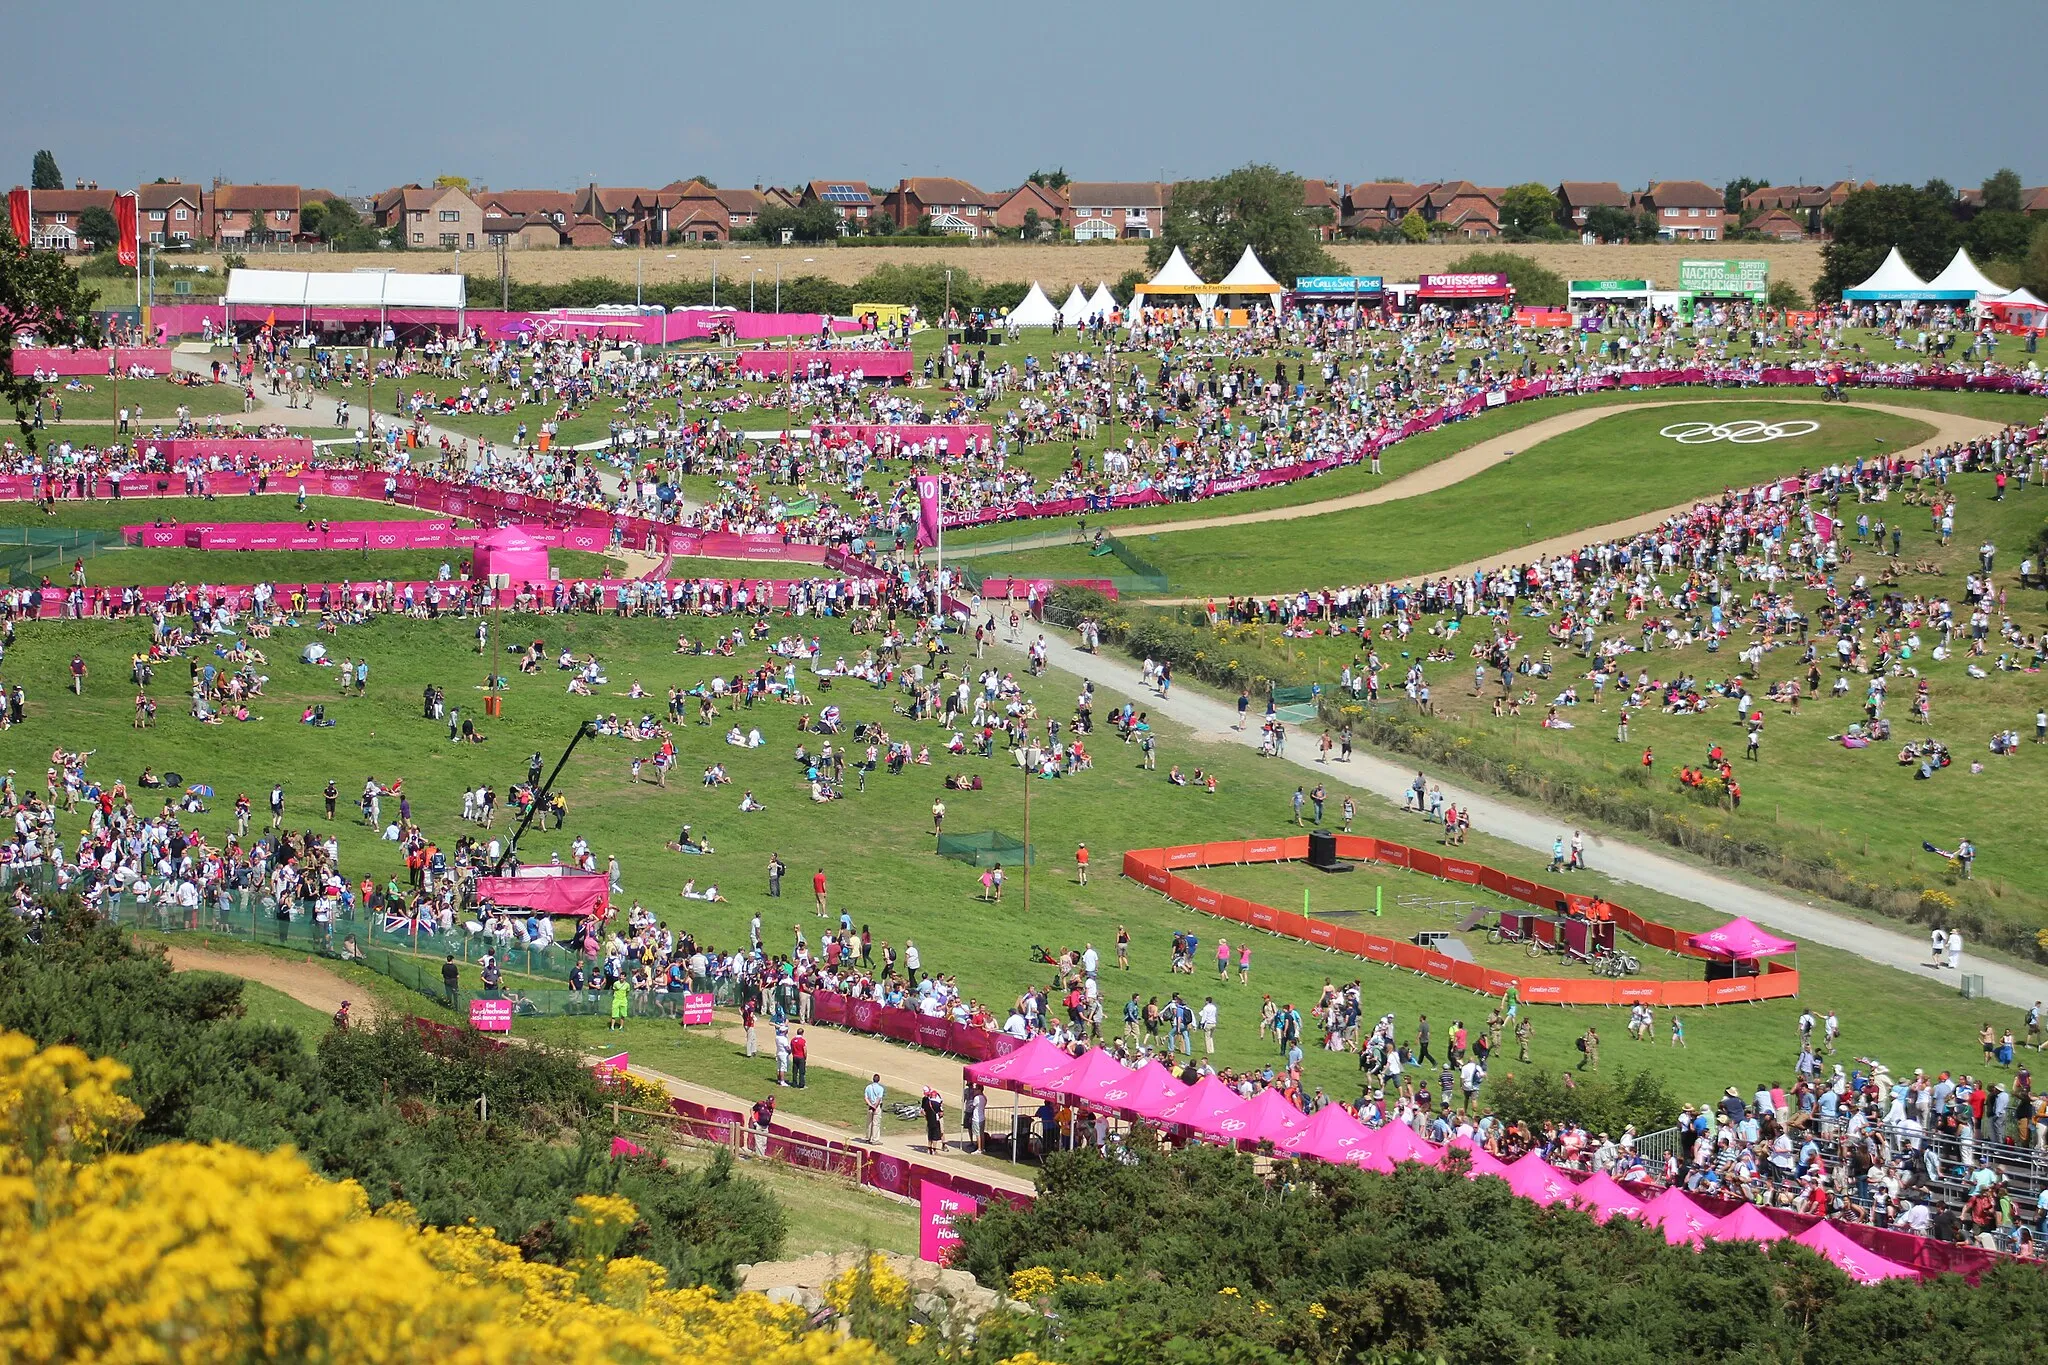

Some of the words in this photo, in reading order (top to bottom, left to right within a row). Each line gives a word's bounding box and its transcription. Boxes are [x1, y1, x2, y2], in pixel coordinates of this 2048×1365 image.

[1682, 267, 1724, 280] NACHOS
[1741, 269, 1764, 280] BEEF
[1701, 279, 1743, 291] CHICKEN
[1582, 377, 1603, 386] 2012
[1860, 373, 1894, 384] London
[1896, 373, 1915, 384] 2012
[1213, 478, 1241, 491] London
[1243, 473, 1259, 486] 2012
[918, 481, 935, 499] 10
[958, 509, 981, 523] 2012
[671, 529, 685, 537] London
[685, 531, 698, 539] 2012
[748, 546, 767, 554] London
[1529, 985, 1547, 993] London
[1548, 986, 1560, 994] 2012
[1622, 988, 1640, 996] London
[1641, 988, 1653, 996] 2012
[919, 1025, 935, 1035] London
[935, 1027, 947, 1037] 2012
[977, 1074, 991, 1084] London
[991, 1077, 999, 1085] 2012
[1033, 1087, 1046, 1097] London
[1046, 1089, 1056, 1098] 2012
[1090, 1101, 1103, 1111] London
[1103, 1105, 1112, 1114] 2012
[1204, 1131, 1220, 1142] London
[1220, 1135, 1230, 1144] 2012
[810, 1148, 823, 1160] 2012
[940, 1199, 959, 1211] The
